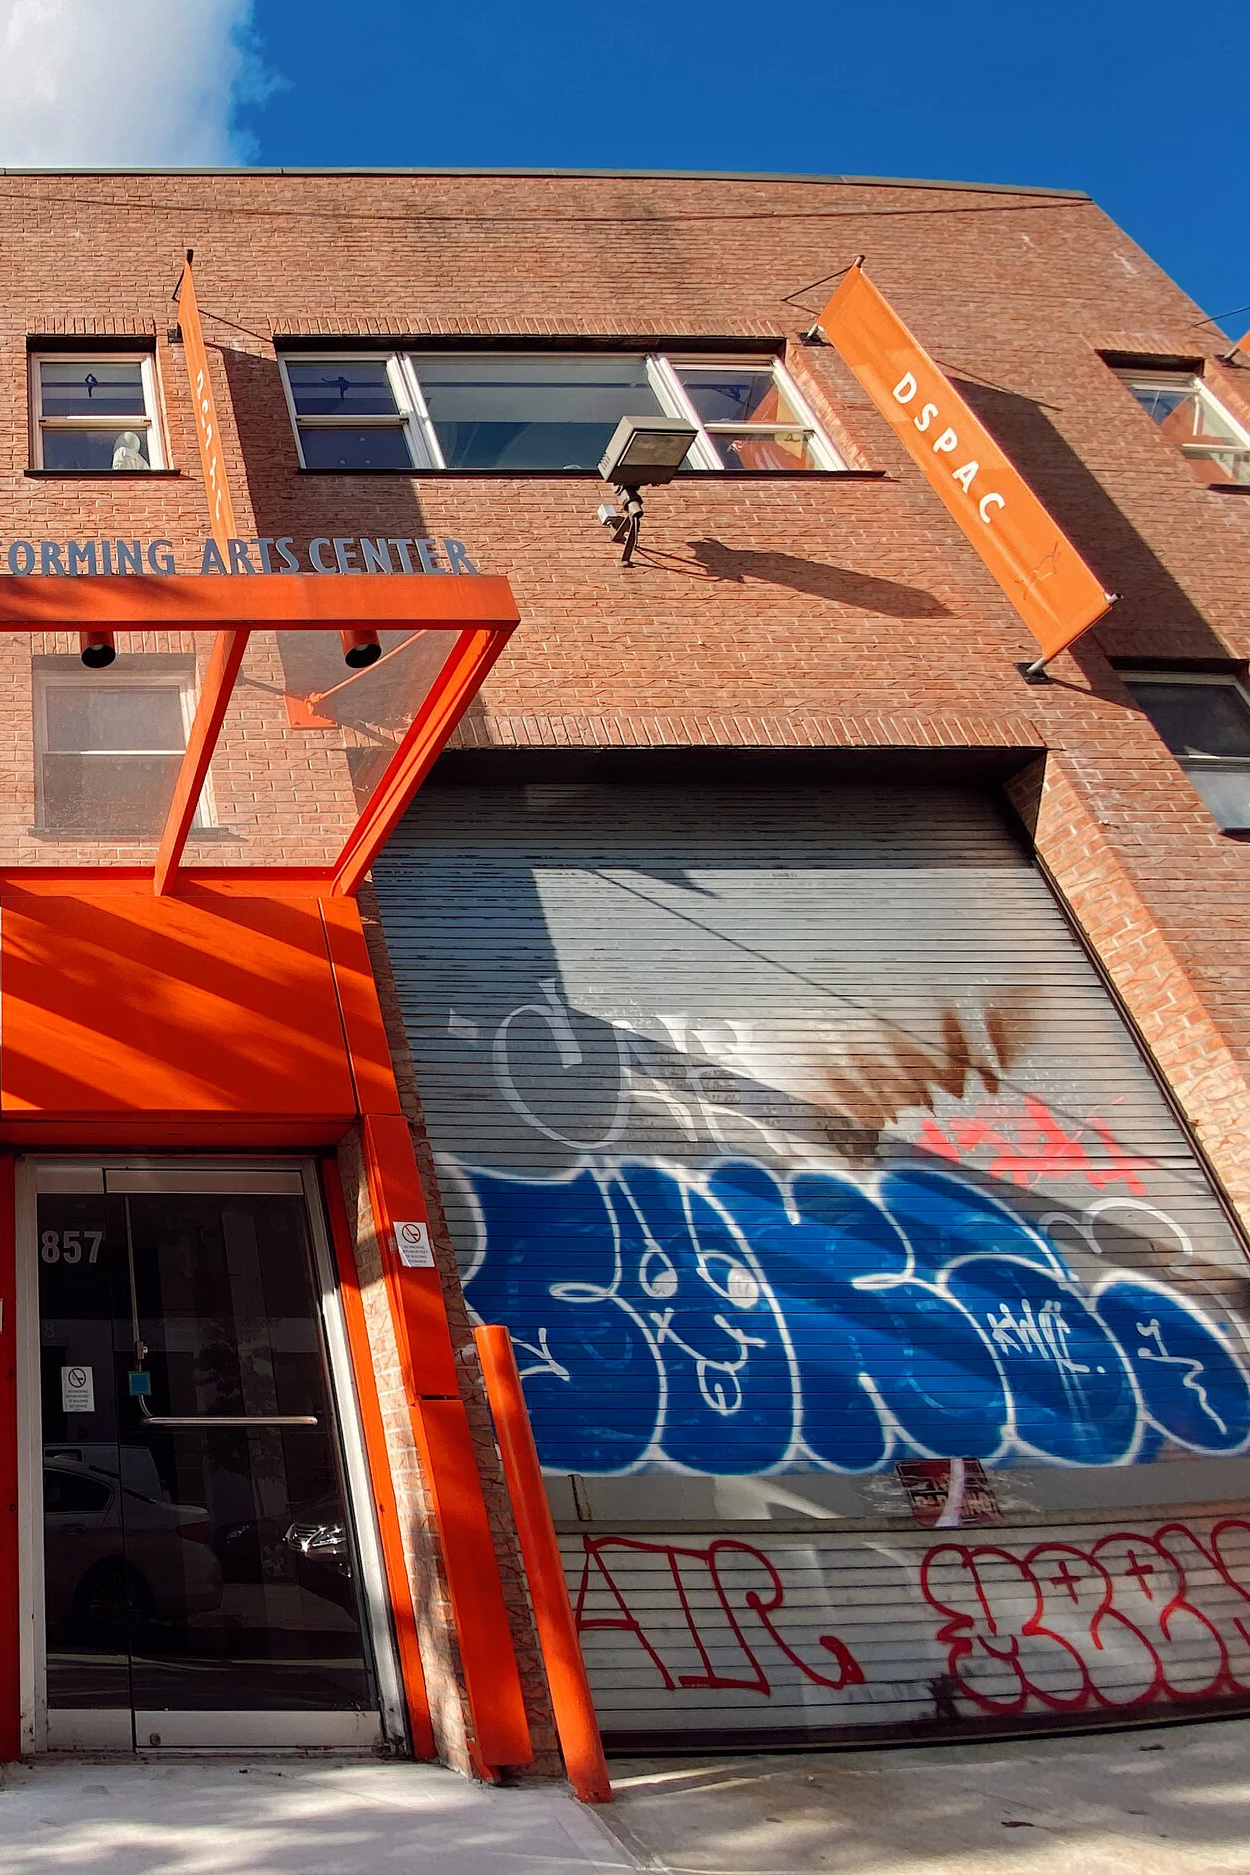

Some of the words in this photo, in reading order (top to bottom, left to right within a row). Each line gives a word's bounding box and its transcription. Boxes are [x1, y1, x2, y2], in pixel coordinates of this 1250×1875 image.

[892, 371, 1006, 524] DSPAC
[200, 537, 300, 576] ARTS
[306, 537, 483, 576] CENTER
[41, 1230, 103, 1264] 857
